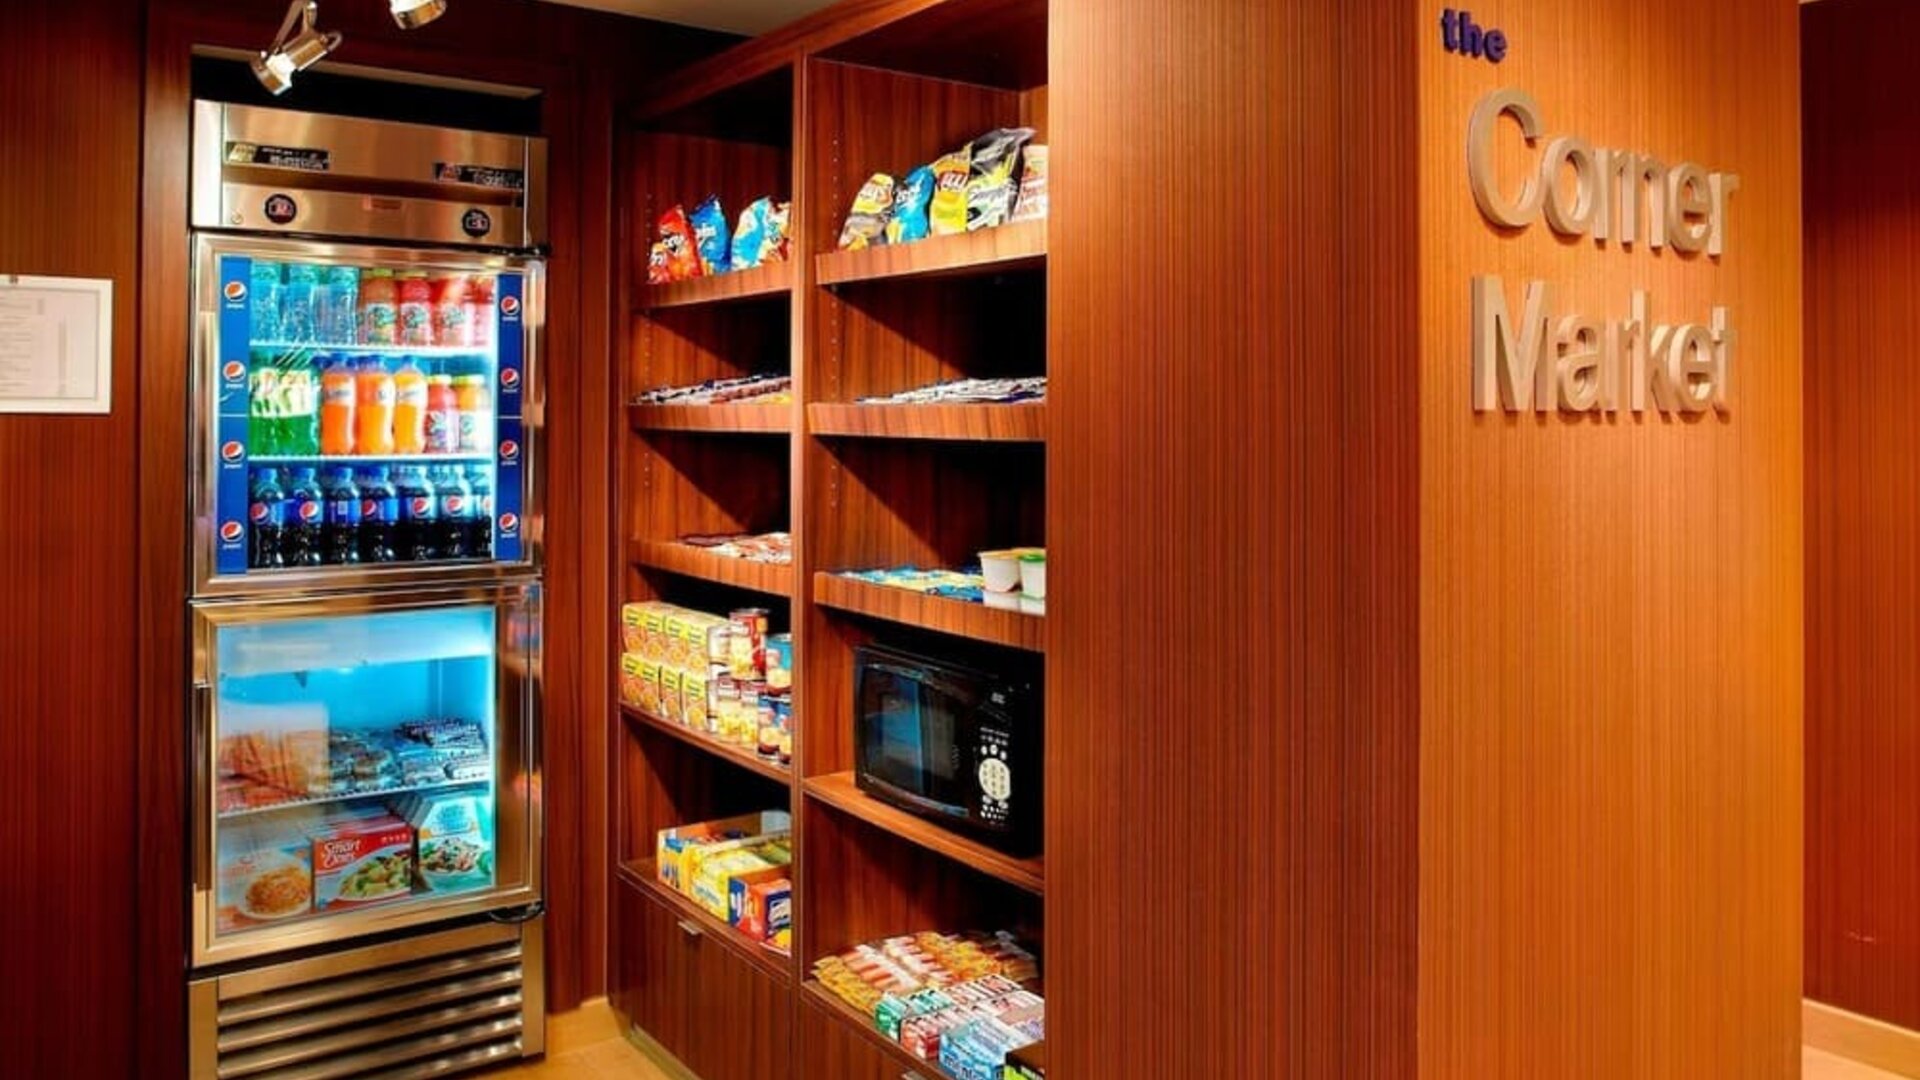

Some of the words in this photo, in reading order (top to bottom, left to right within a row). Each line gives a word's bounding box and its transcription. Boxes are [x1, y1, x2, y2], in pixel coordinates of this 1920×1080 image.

[1441, 9, 1507, 62] the
[1467, 87, 1740, 259] Corner
[1471, 275, 1736, 415] Market
[323, 839, 362, 856] Smart
